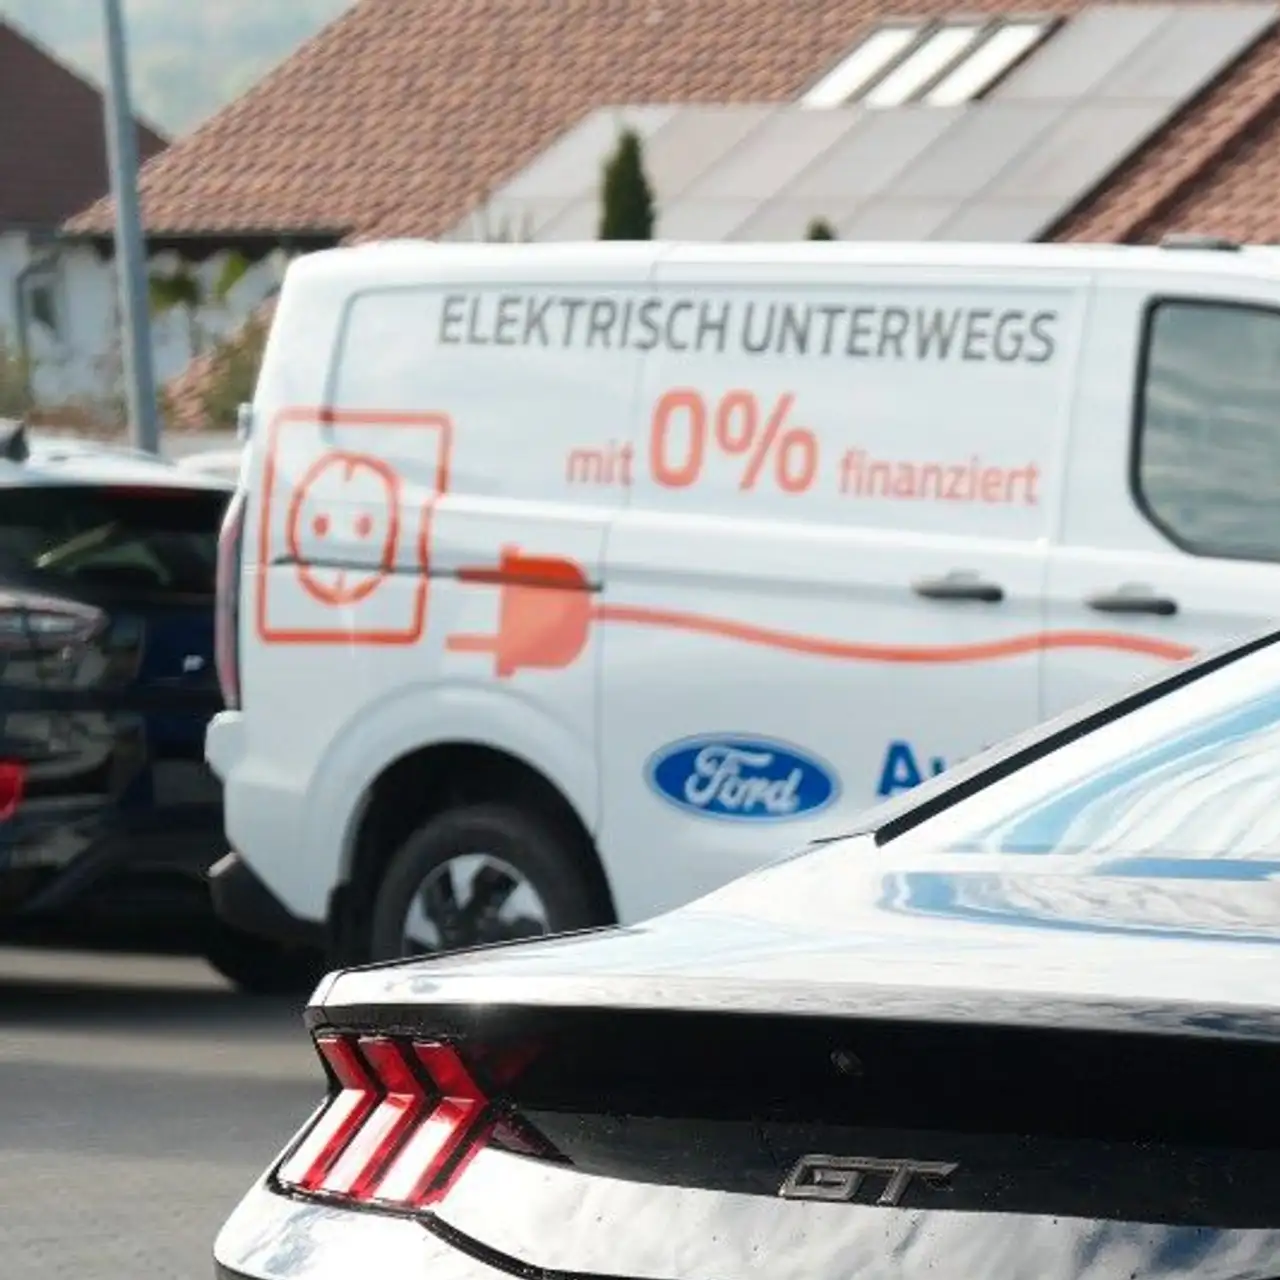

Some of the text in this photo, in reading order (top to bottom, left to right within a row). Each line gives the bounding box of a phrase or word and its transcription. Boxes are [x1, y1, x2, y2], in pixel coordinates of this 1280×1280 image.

[438, 294, 1057, 363] ELEKTRISCH UNTERWEGS
[566, 387, 1041, 506] mit 0% finanziert
[682, 740, 804, 817] Ford
[777, 1153, 959, 1206] GT
